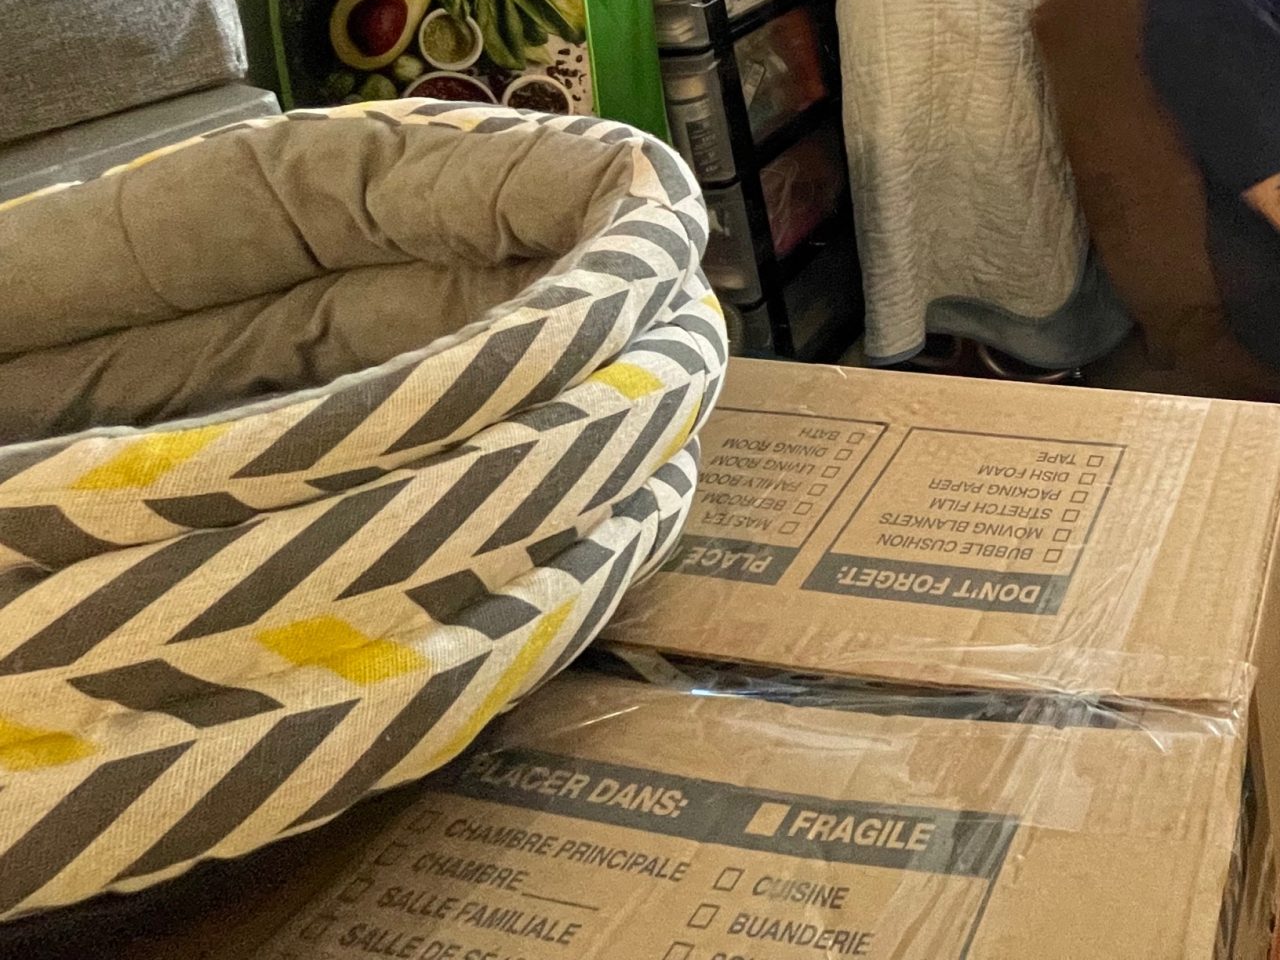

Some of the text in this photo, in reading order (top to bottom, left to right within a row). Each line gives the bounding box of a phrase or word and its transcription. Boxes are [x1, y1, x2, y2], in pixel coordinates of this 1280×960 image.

[799, 427, 841, 440] BATH
[722, 437, 828, 458] DINING ROOM
[1036, 451, 1076, 465] TAPE
[710, 454, 815, 476] LIVING ROOM
[977, 464, 1070, 482] DISH FOAM
[745, 476, 803, 491] FAMILY
[928, 478, 1062, 501] PACKING PAPER
[701, 492, 787, 511] BEDROOM
[929, 497, 1053, 520] STRETCH FILM
[701, 511, 773, 531] MASTER
[878, 512, 1043, 539] MOVING BLANKETS
[682, 546, 773, 573] PLACE
[876, 533, 1034, 561] BUBBLE CUSHION
[838, 566, 1041, 605] DON'T FORGET:
[586, 776, 690, 819] DANS:
[788, 810, 936, 852] FRAGILE
[444, 817, 692, 883] CHAMBRE PRINCIPALE
[411, 850, 531, 890] CHAMBRE
[752, 875, 851, 910] CUISINE
[376, 886, 582, 946] SALLE FAMILIALE
[339, 922, 424, 959] SALLE
[727, 912, 875, 957] BUANDERIE
